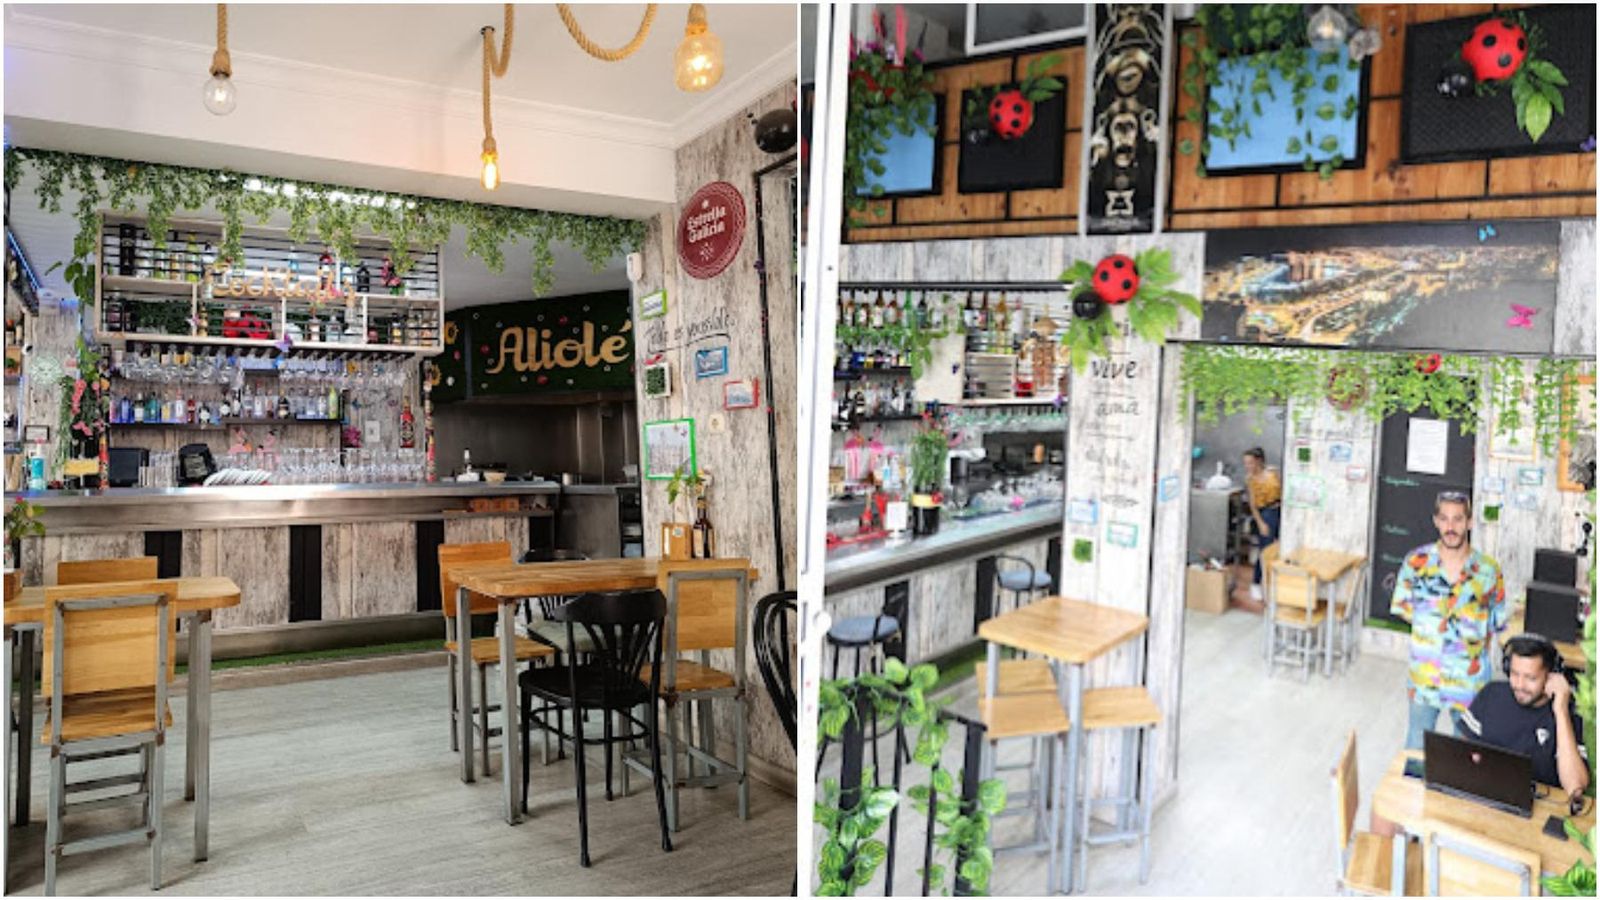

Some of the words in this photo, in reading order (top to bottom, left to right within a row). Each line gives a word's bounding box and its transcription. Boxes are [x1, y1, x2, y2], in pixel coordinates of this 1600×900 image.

[687, 206, 726, 231] Estrella
[688, 220, 726, 243] Galicia
[485, 320, 632, 374] Aliolé
[1091, 360, 1137, 379] vive
[1094, 401, 1141, 417] ama
